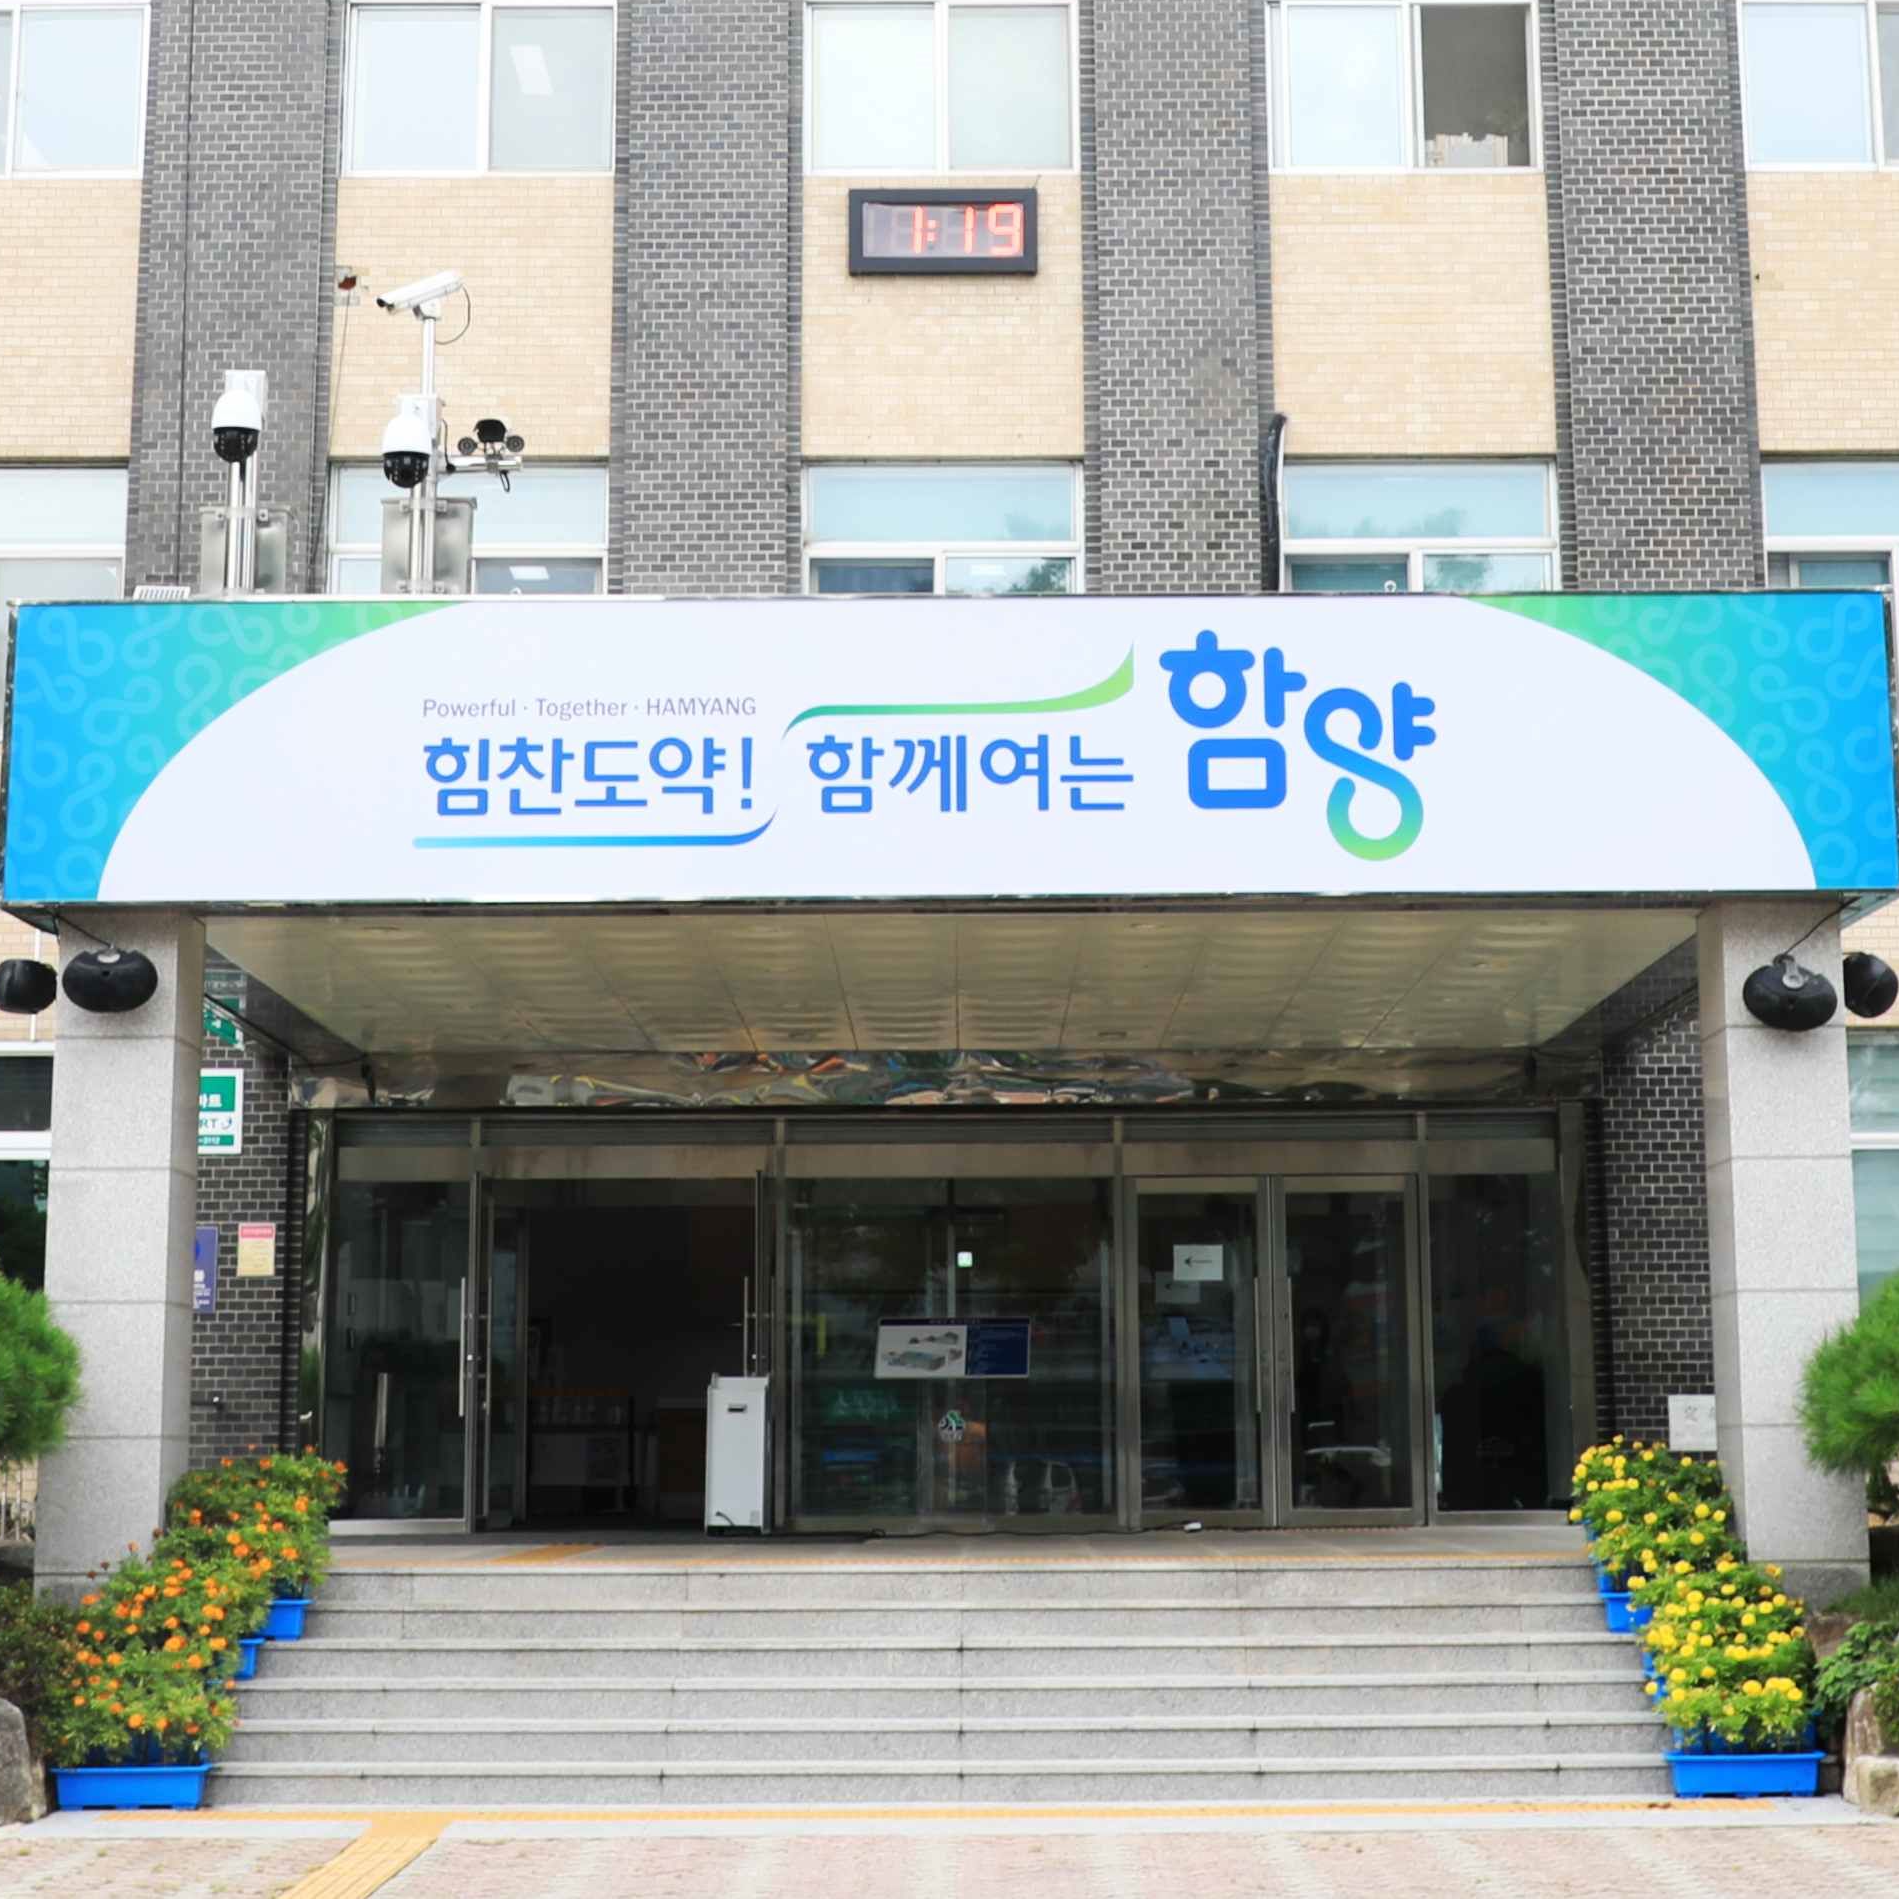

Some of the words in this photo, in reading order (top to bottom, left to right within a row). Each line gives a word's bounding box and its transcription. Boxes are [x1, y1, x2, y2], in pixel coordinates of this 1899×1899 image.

[911, 202, 1024, 256] 1:19
[422, 697, 516, 715] Powerful
[535, 697, 628, 721] Together
[646, 697, 757, 717] HAMYANG
[422, 737, 753, 816] 힘찬도약!
[806, 733, 1135, 815] 함께여는
[1160, 629, 1438, 863] 함양
